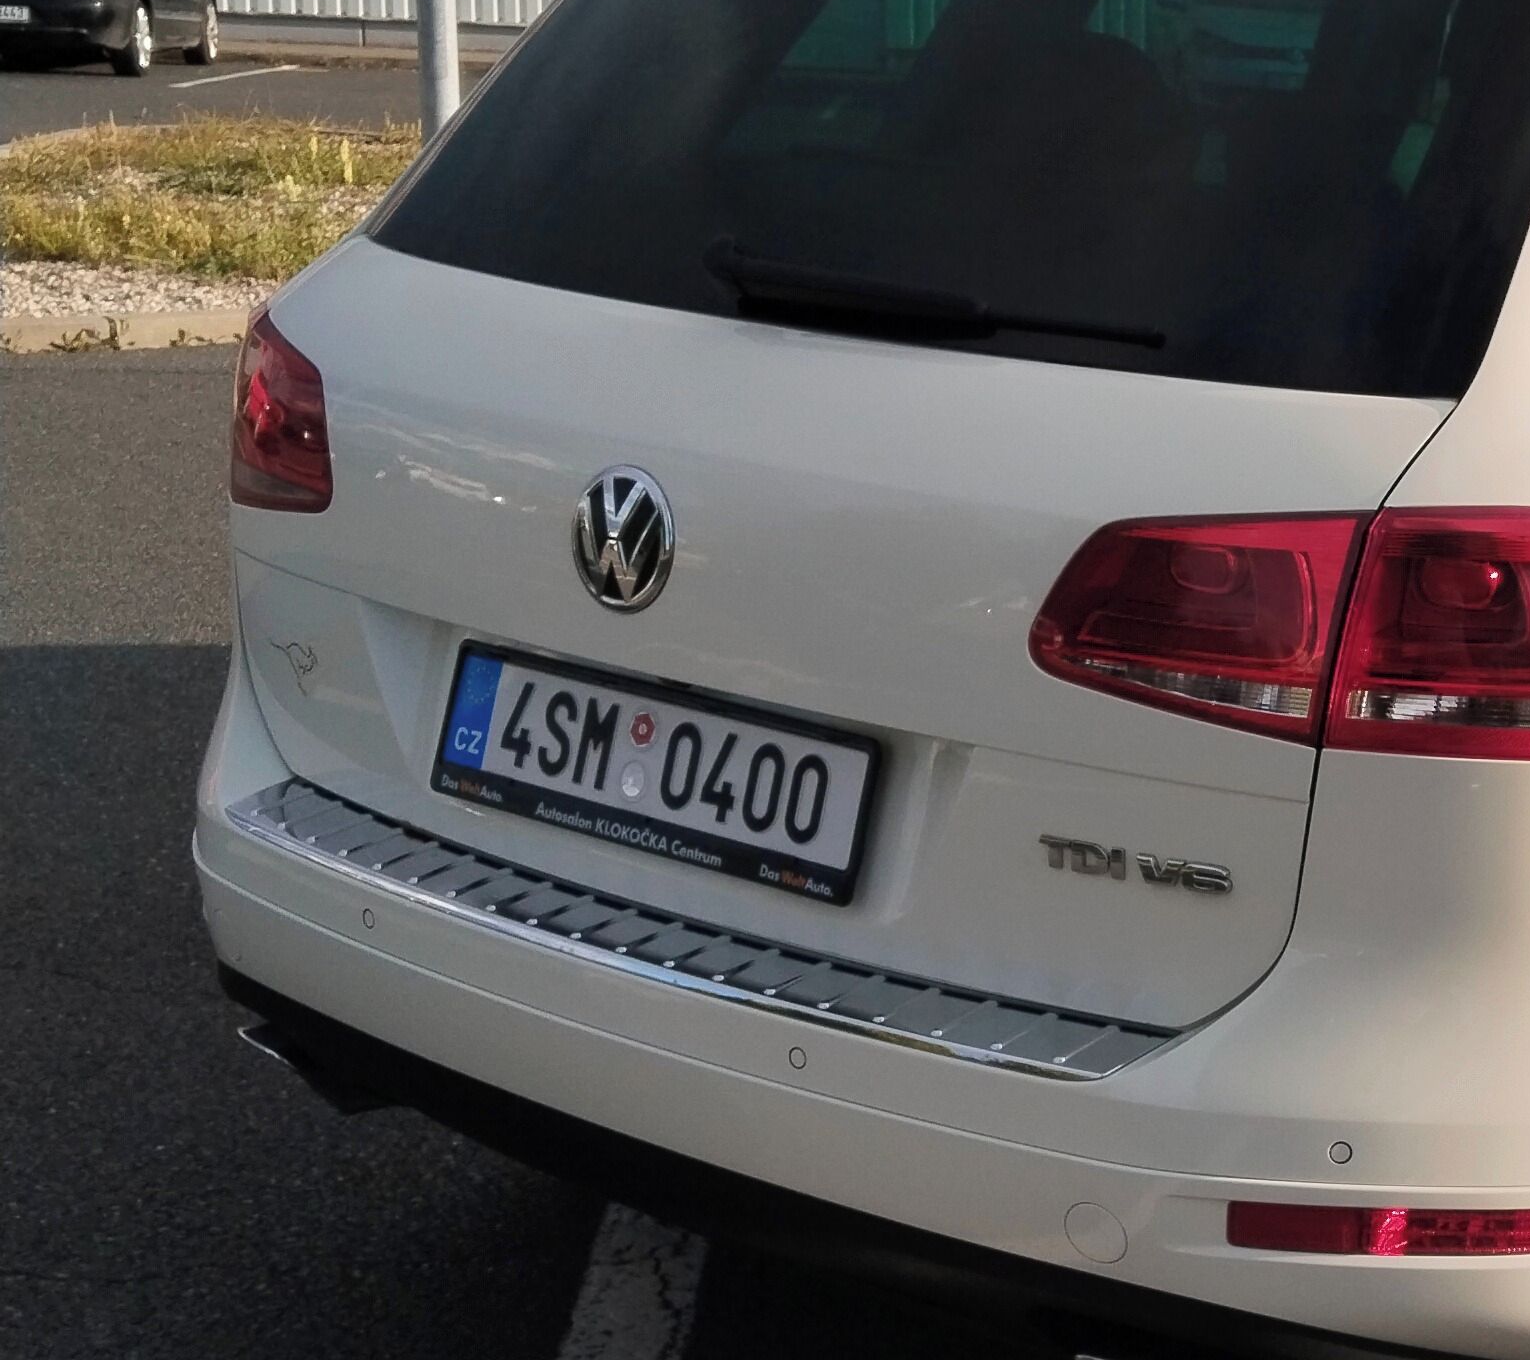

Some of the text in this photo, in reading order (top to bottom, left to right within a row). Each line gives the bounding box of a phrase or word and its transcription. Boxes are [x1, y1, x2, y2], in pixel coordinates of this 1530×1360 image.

[455, 726, 482, 755] CZ
[500, 682, 829, 844] 4SM 0400
[535, 801, 722, 867] Autosalon KLOKOČKA Centrum
[1038, 833, 1234, 894] TDI V6
[759, 863, 780, 882] Das
